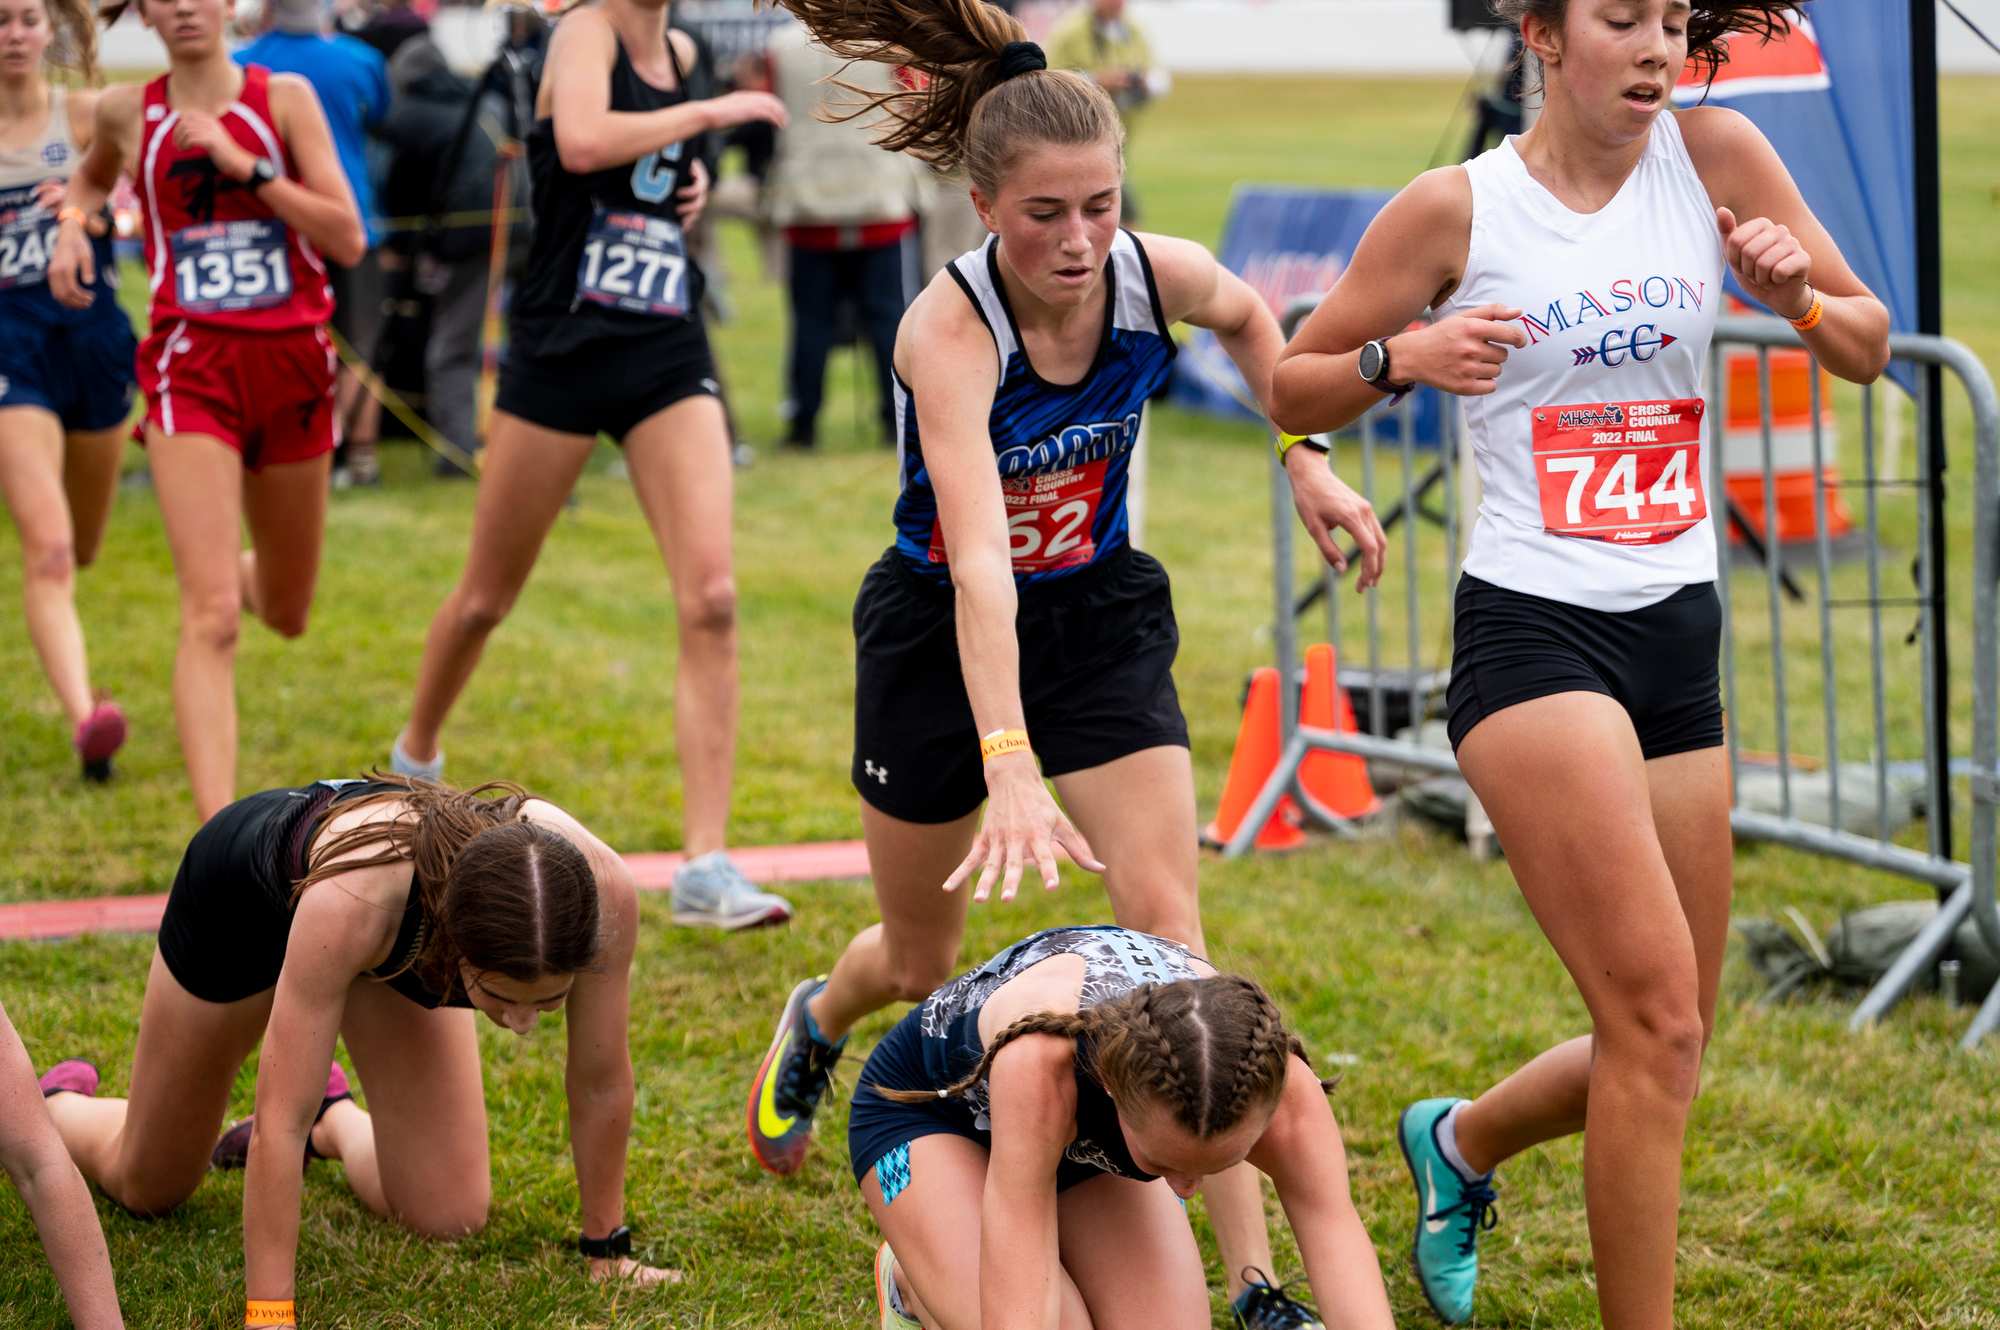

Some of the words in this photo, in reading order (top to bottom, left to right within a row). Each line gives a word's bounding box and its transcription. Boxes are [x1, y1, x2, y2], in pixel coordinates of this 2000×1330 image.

[175, 247, 290, 302] 1351
[584, 239, 686, 304] 1277
[1518, 276, 1706, 346] MASON
[1600, 324, 1658, 369] CC
[1557, 408, 1615, 427] MHSAA
[1628, 404, 1671, 416] CROSS
[1628, 414, 1682, 428] COUNTRY
[1592, 431, 1622, 445] 2022
[1625, 430, 1658, 444] FINAL
[1034, 472, 1086, 494] COUNTRY
[1036, 469, 1074, 485] CROSS
[1546, 449, 1696, 524] 744
[1029, 491, 1059, 505] FINAL
